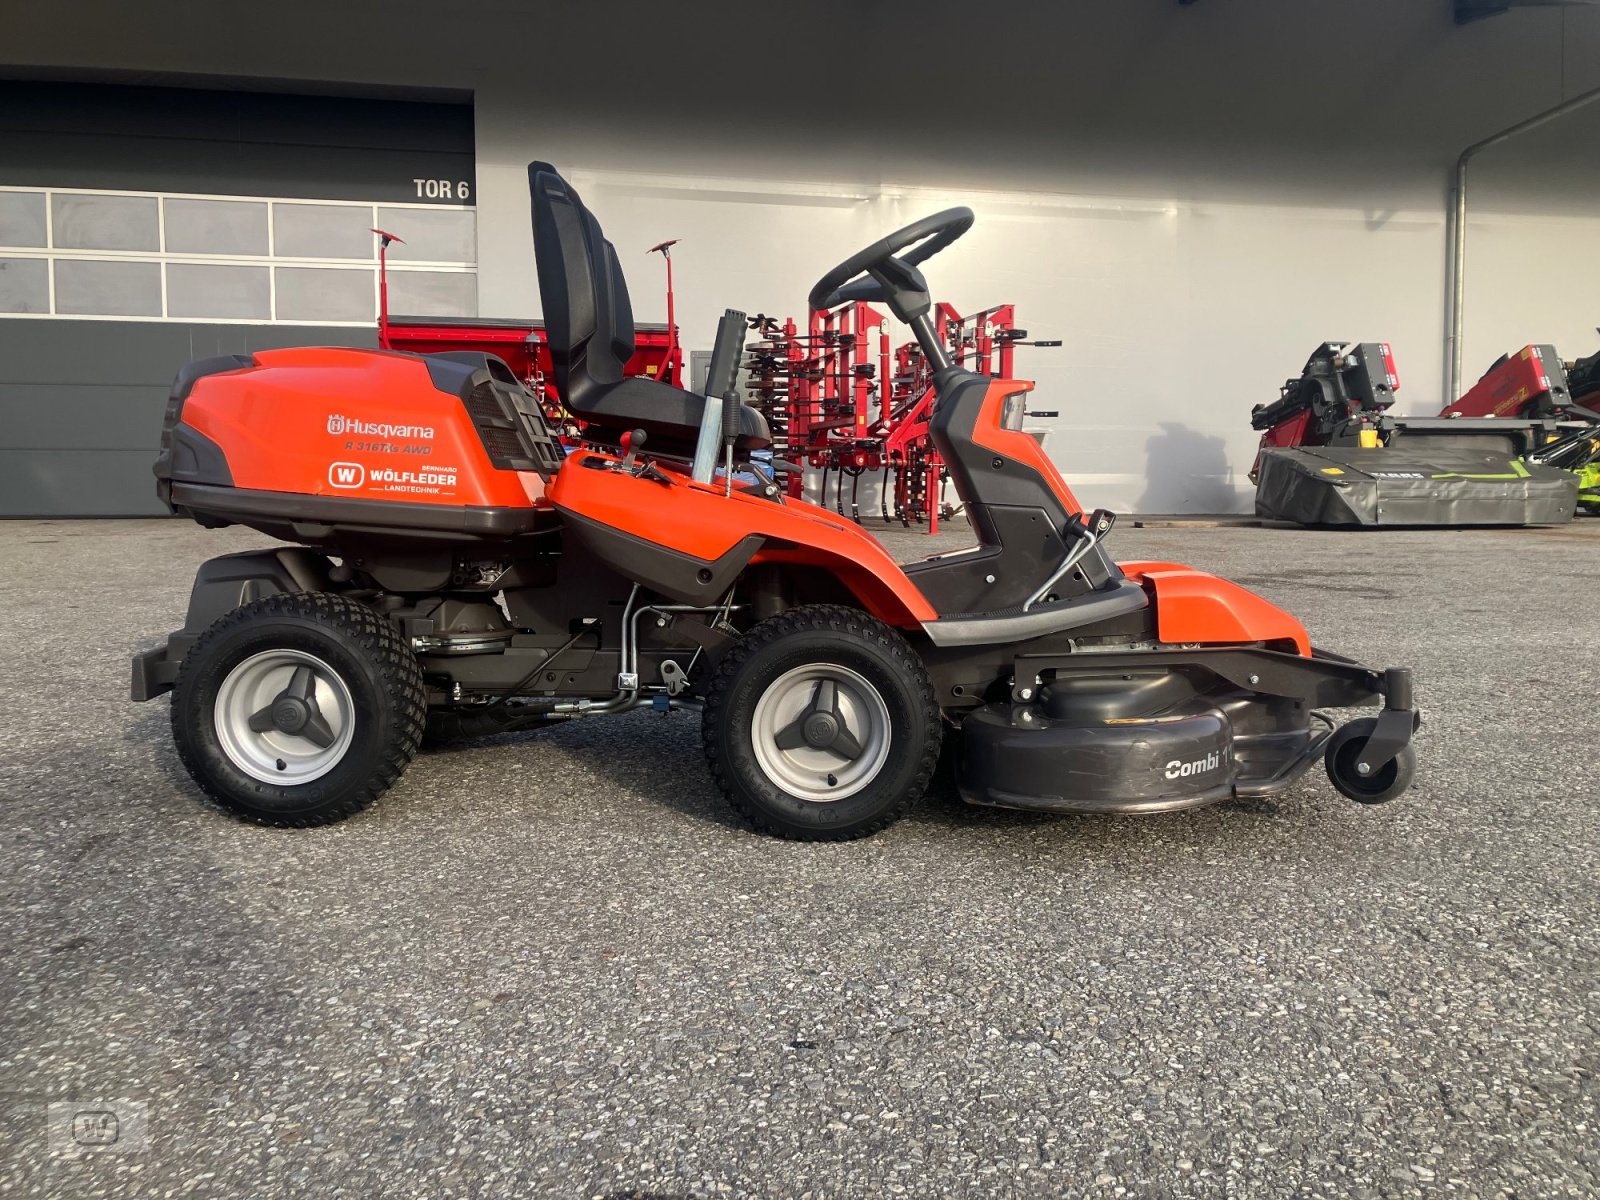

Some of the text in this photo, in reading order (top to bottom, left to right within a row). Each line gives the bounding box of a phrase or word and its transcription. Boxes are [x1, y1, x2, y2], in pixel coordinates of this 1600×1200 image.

[413, 179, 470, 199] TOR 6
[345, 418, 434, 439] Husqvarna
[345, 441, 353, 450] R
[402, 445, 432, 455] AWD
[337, 467, 356, 483] W
[370, 468, 457, 486] WÖLFLEDER
[422, 465, 457, 473] BERNHARD
[384, 485, 440, 494] LANDTECHNIK
[1165, 750, 1219, 779] Combi
